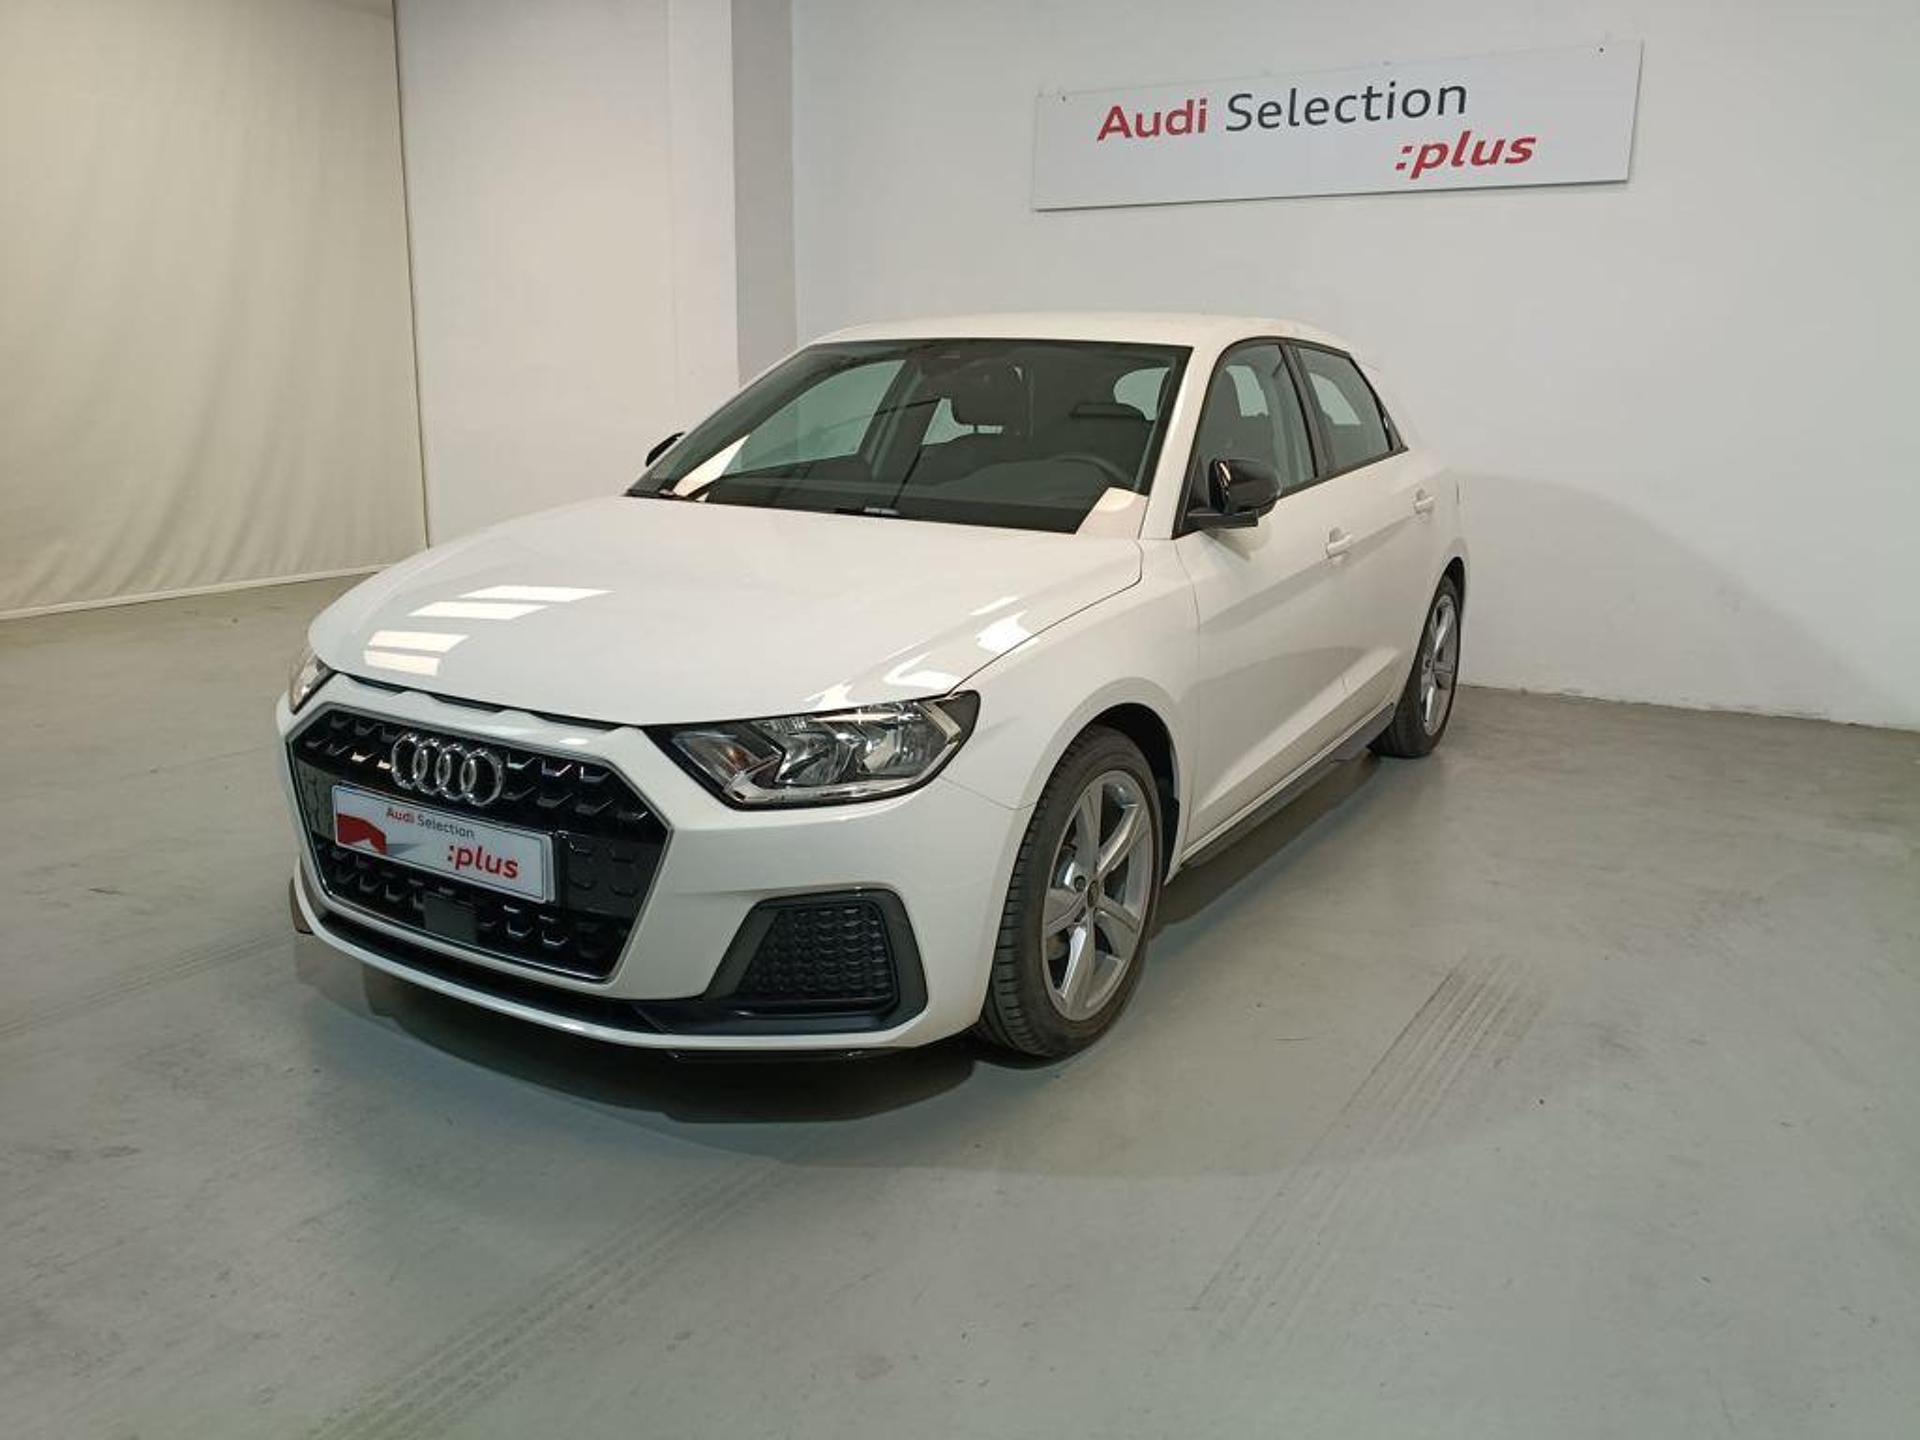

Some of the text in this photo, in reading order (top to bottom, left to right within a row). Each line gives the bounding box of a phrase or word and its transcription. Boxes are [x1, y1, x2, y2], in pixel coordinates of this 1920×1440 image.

[1098, 81, 1467, 142] Audi Selection
[1394, 130, 1537, 179] :plus
[386, 807, 475, 839] Audi Selection
[447, 844, 519, 880] :plus
